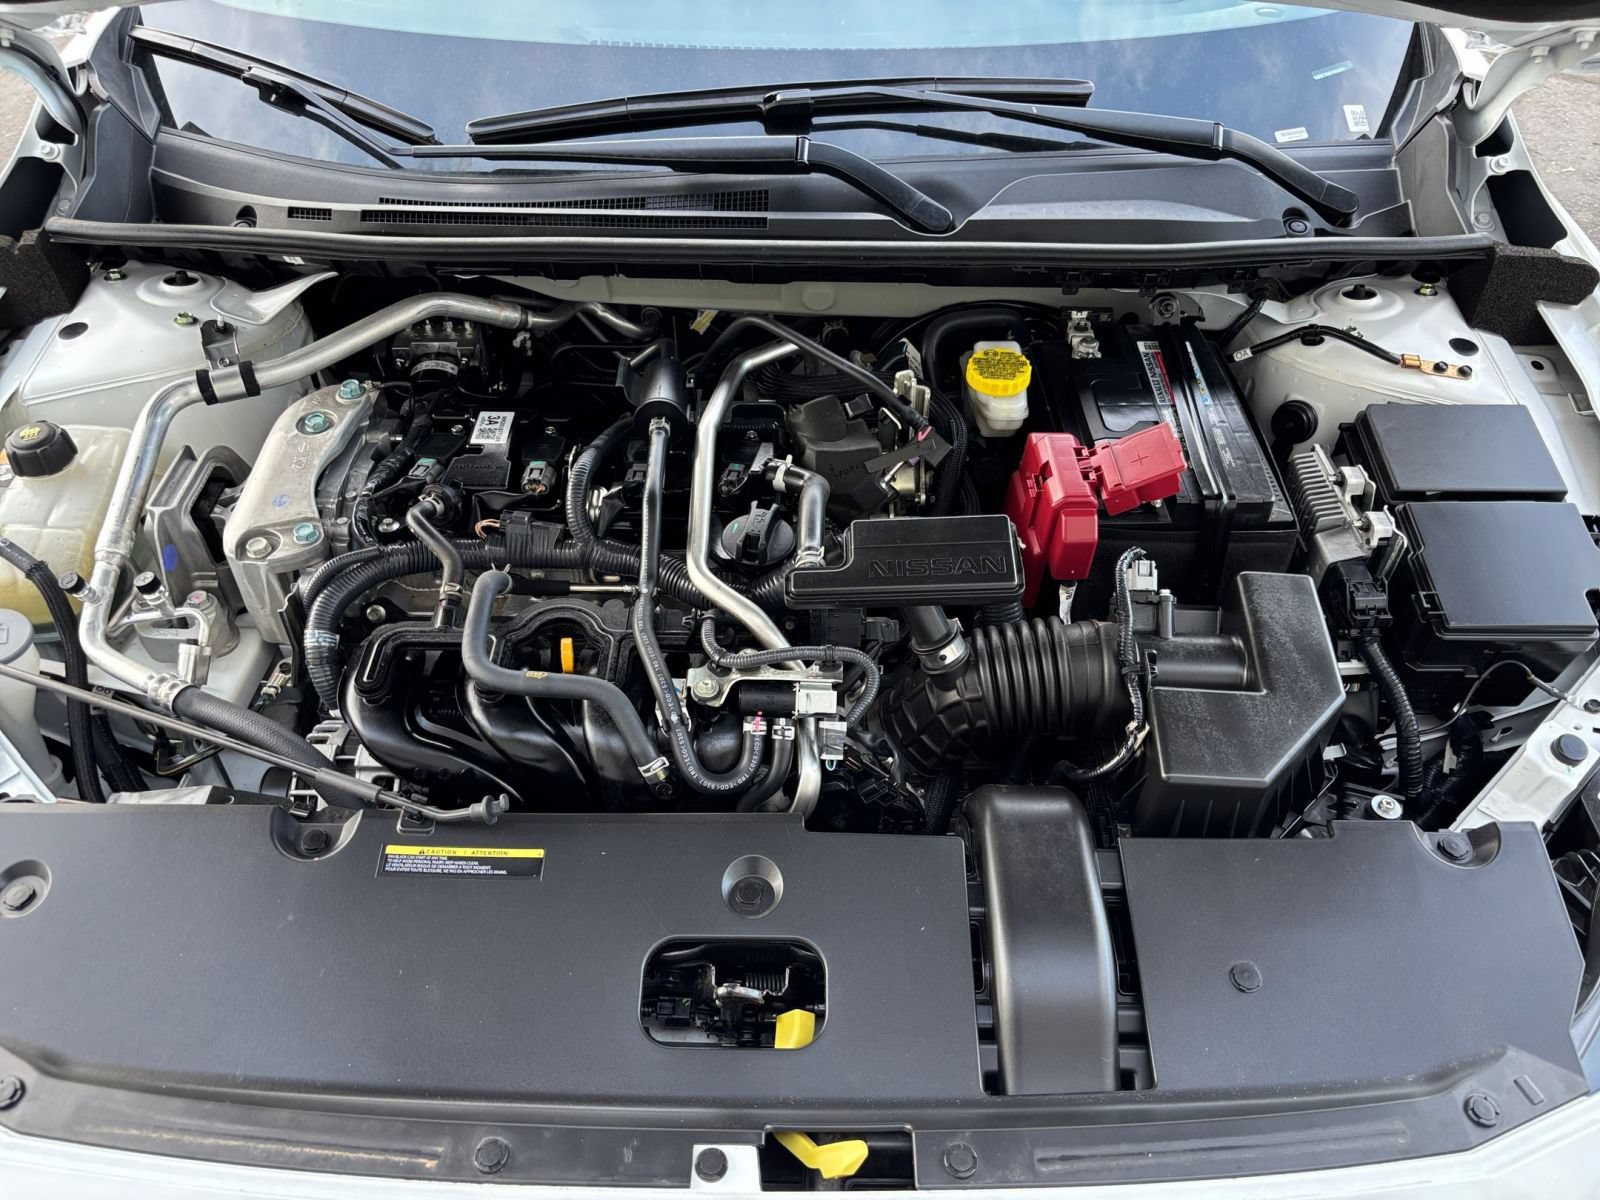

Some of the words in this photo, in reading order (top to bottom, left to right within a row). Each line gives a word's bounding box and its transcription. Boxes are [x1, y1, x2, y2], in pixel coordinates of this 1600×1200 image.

[1142, 351, 1158, 379] NISSAN
[1151, 379, 1167, 404] RENAULT
[485, 415, 501, 426] 3A
[868, 553, 1007, 578] NISSAN
